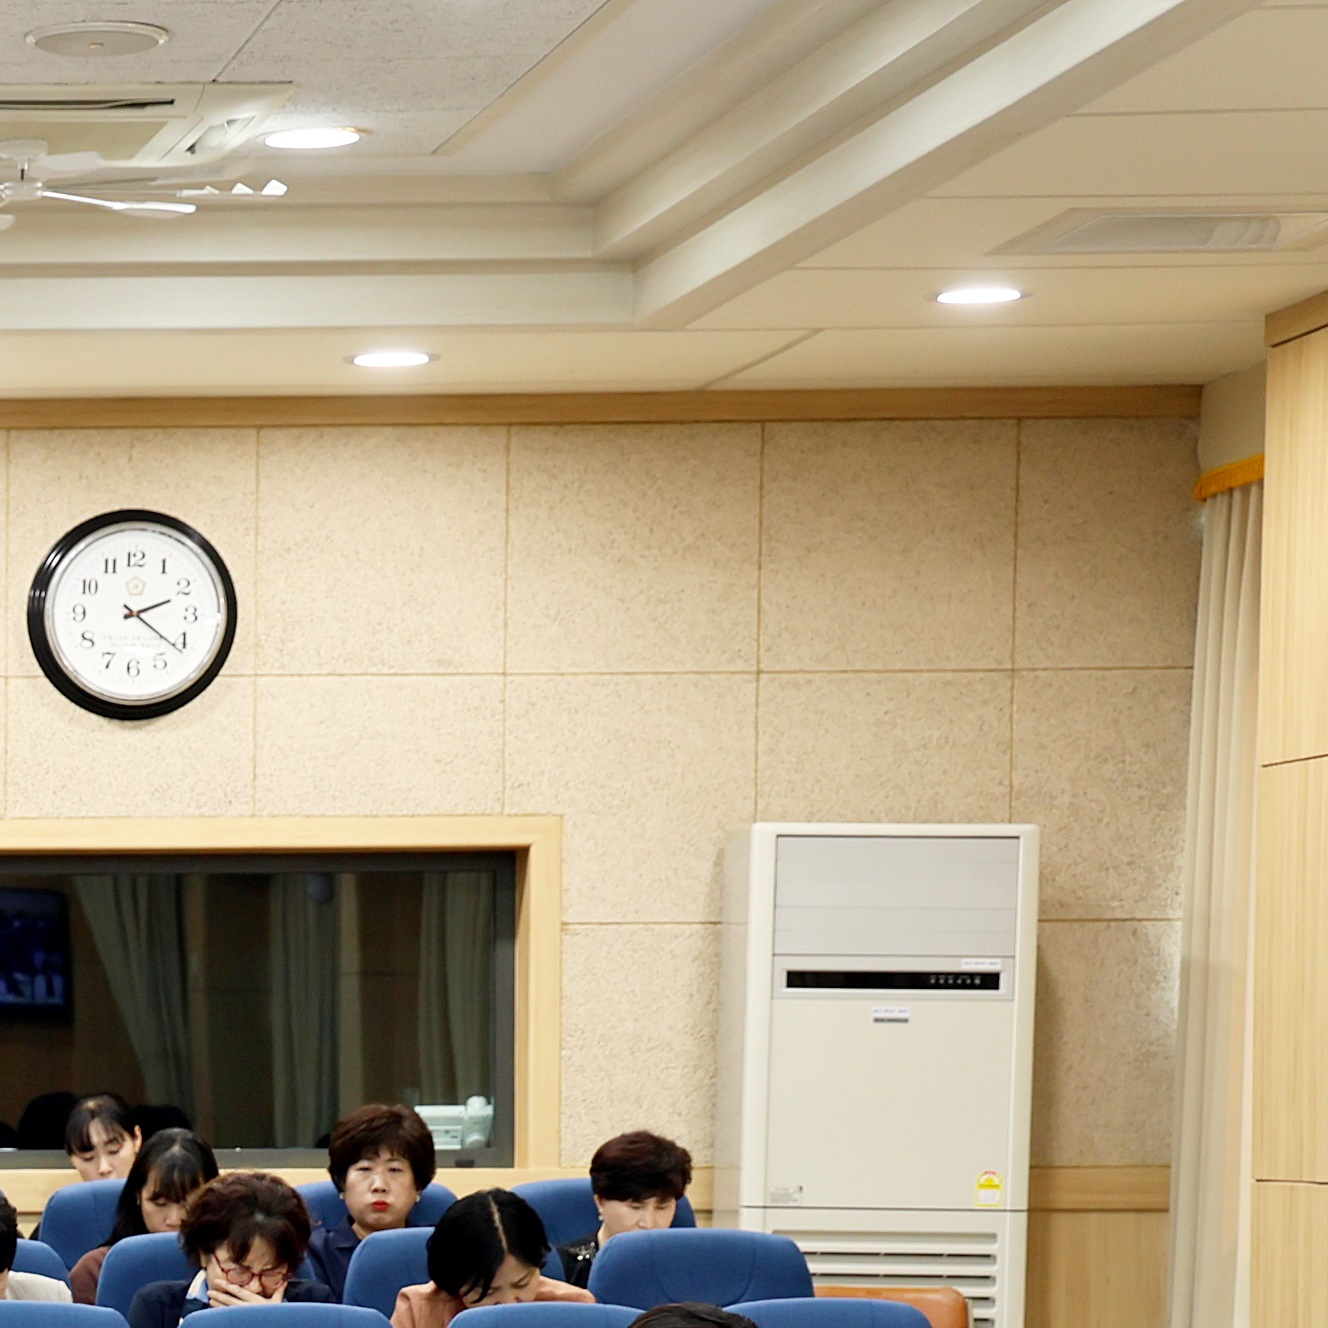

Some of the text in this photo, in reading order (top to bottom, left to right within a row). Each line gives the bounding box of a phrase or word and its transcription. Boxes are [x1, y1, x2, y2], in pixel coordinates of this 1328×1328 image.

[103, 558, 117, 574] 11
[126, 550, 145, 568] 12
[160, 558, 168, 574] 1
[81, 579, 98, 595] 10
[176, 579, 191, 595] 2
[72, 604, 86, 622] 9
[184, 605, 198, 623] 3
[81, 631, 95, 648] 8
[172, 632, 187, 650] 4
[101, 652, 115, 669] 7
[126, 660, 140, 678] 6
[153, 653, 167, 670] 5
